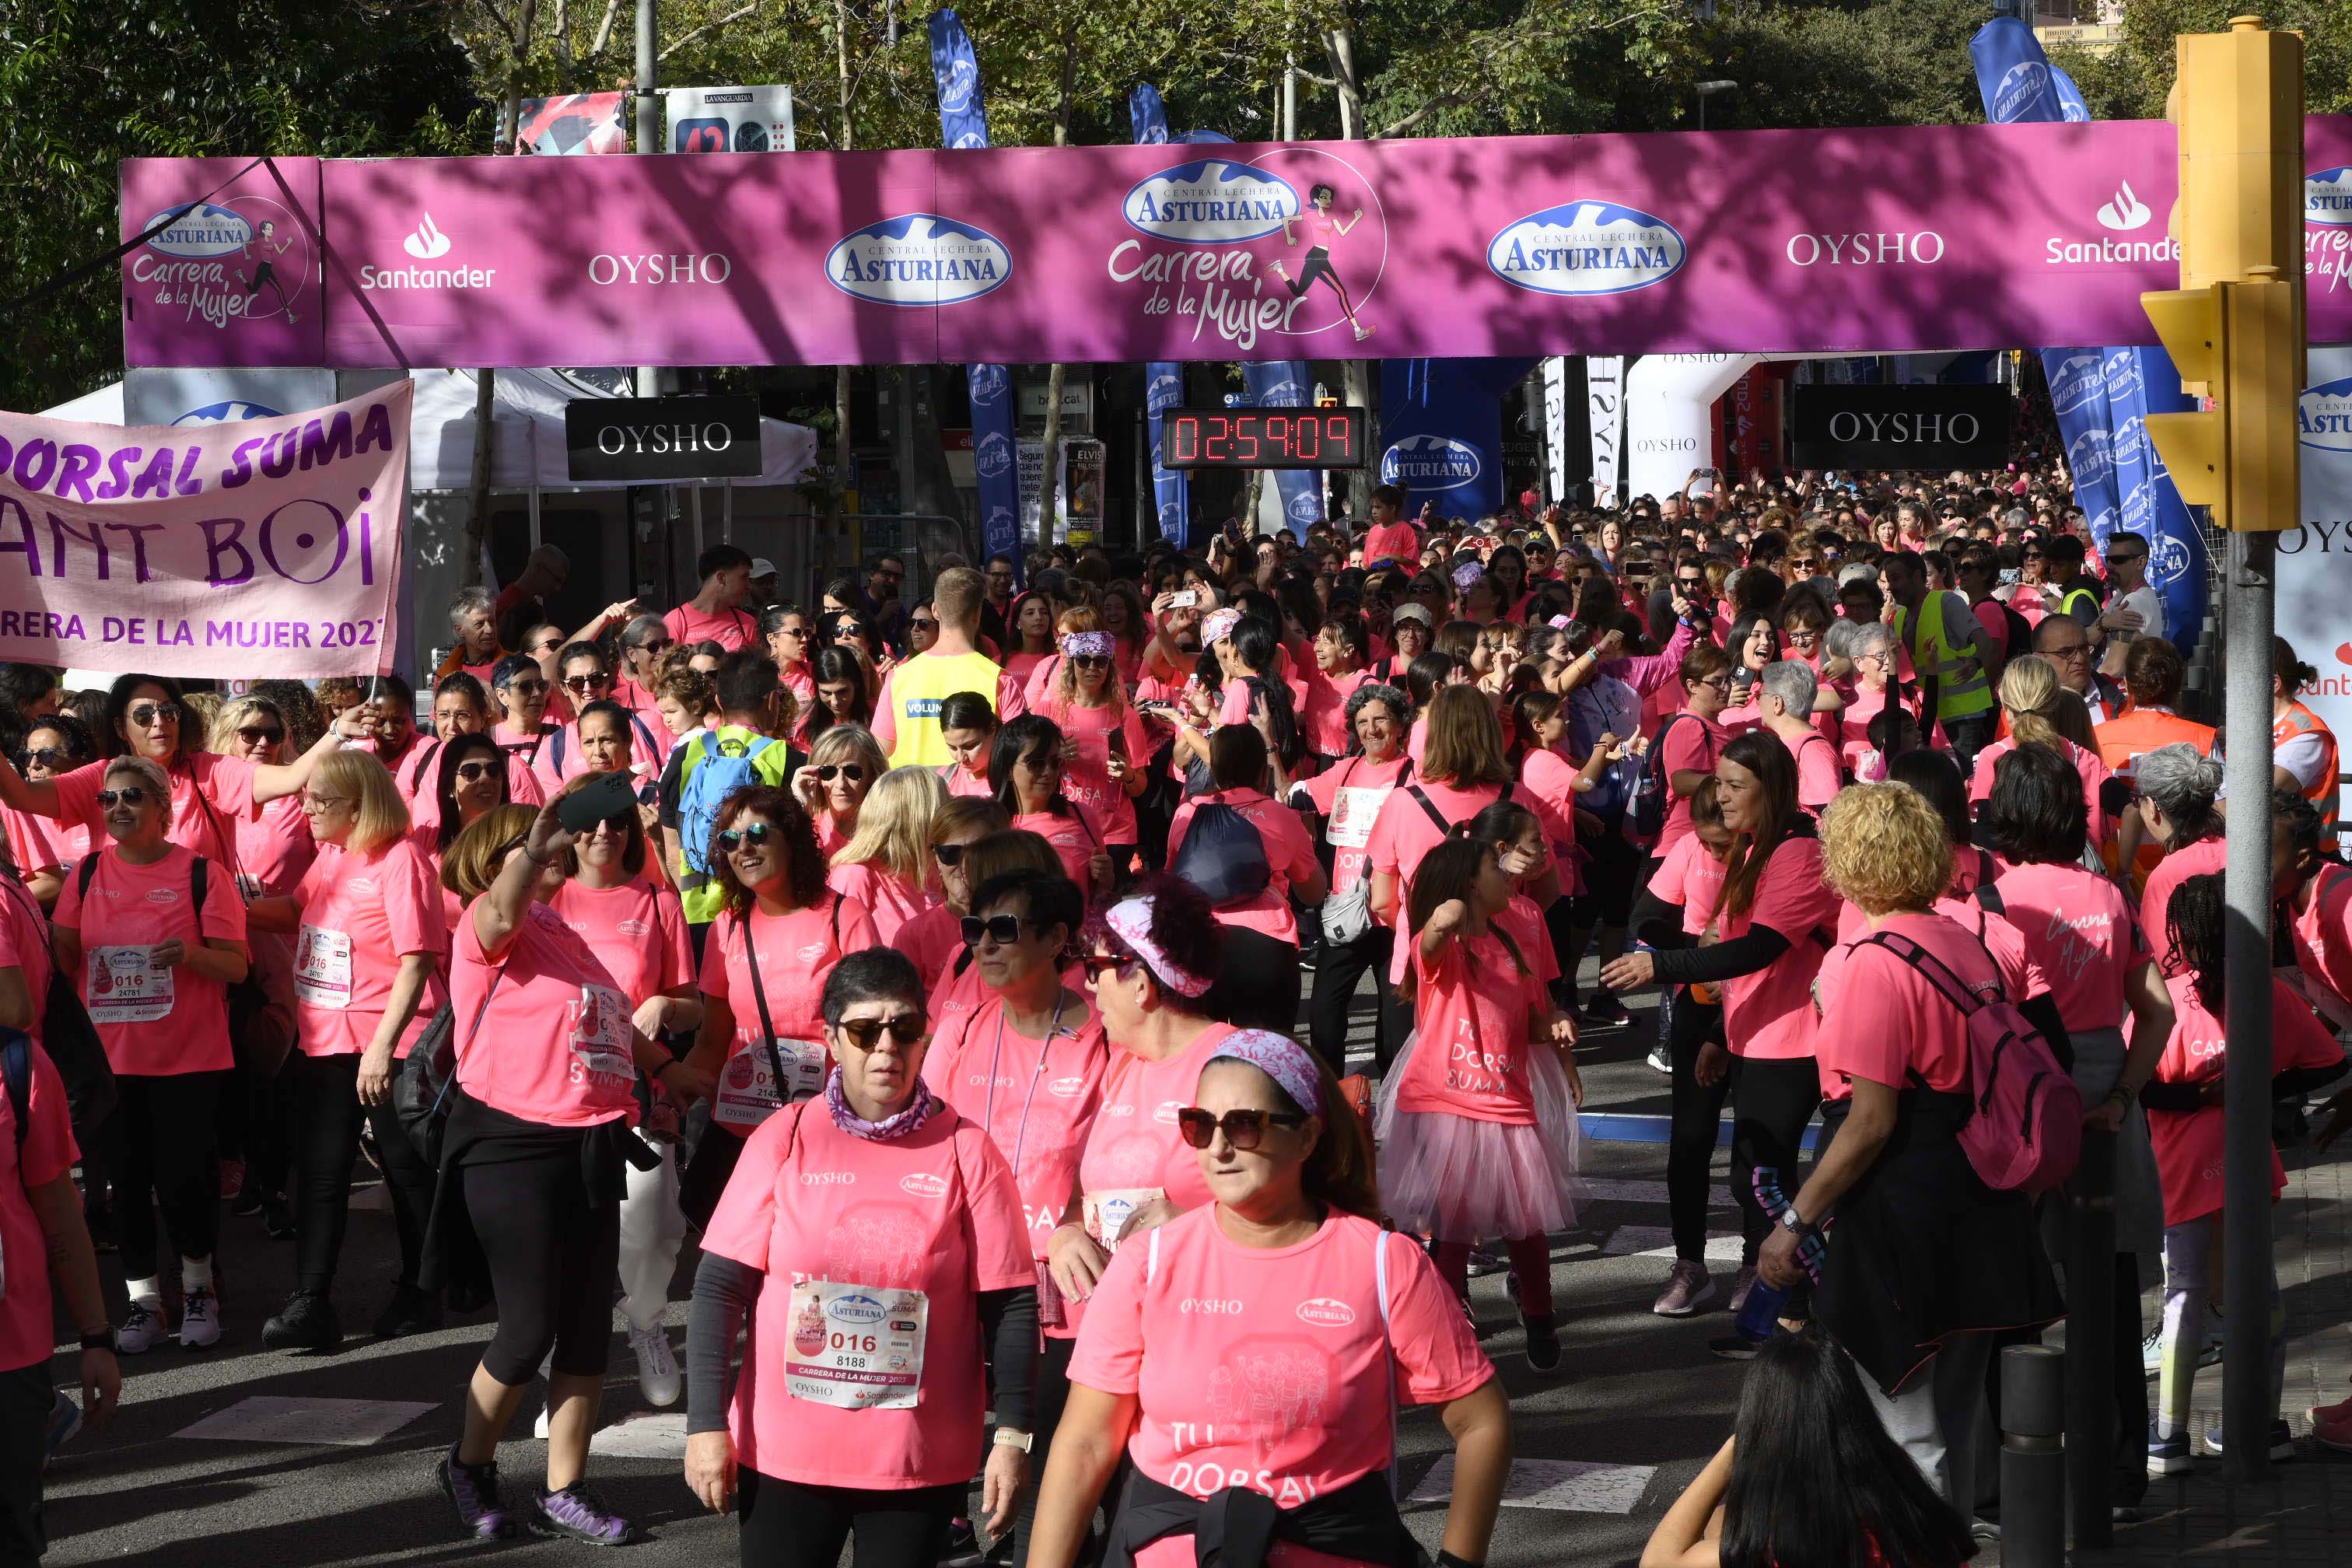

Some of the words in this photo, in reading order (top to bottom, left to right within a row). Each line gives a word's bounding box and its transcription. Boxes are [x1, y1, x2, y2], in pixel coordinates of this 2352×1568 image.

[714, 93, 753, 103] VANGUARDIA
[1164, 187, 1219, 197] CENTRAL
[1225, 187, 1281, 196] LECHERA
[1136, 191, 1284, 222] ASTURIANA
[1534, 233, 1594, 243] CENTRAL
[1601, 232, 1664, 242] LECHERA
[869, 245, 926, 254] CENTRAL
[933, 244, 991, 254] LECHERA
[1503, 236, 1671, 271] ASTURIANA
[1787, 231, 1944, 266] OYSHO
[2046, 237, 2181, 264] Santande
[132, 254, 224, 283] Carrera
[588, 254, 731, 285] OYSHO
[840, 249, 998, 282] ASTURIANA
[1108, 239, 1254, 282] Carrera
[2319, 251, 2333, 274] la
[360, 265, 496, 289] Santander
[156, 285, 171, 304] de
[176, 285, 187, 304] la
[186, 280, 259, 328] Mujer
[1144, 285, 1170, 314] de
[1177, 285, 1195, 314] la
[1192, 278, 1307, 350] Mujer
[1175, 416, 1349, 459] 02:59:09
[1829, 411, 1979, 443] OYSHO
[221, 404, 394, 489] SUMA
[597, 422, 731, 455] OYSHO
[1637, 438, 1696, 453] OYSHO
[1077, 450, 1102, 460] ELVIS
[1020, 472, 1045, 482] quiere
[1385, 457, 1472, 478] ASTURIANA
[0, 494, 166, 583] ANT
[1, 610, 86, 640] RERA
[103, 618, 145, 644] DE
[156, 619, 190, 646] LA
[206, 620, 311, 648] MUJER
[907, 702, 943, 715] VOLUN
[310, 956, 327, 969] 016
[115, 975, 144, 986] 016
[757, 1088, 780, 1098] 2142
[725, 1108, 757, 1118] OYSHO
[800, 1171, 856, 1186] OYSHO
[831, 1304, 882, 1318] ASTURIANA
[1181, 1299, 1243, 1316] OYSHO
[831, 1332, 877, 1353] 016
[837, 1356, 865, 1368] 8188
[798, 1367, 834, 1379] CARRERA
[835, 1371, 846, 1380] DE
[796, 1382, 833, 1397] OYSHO
[866, 1391, 906, 1399] Santander
